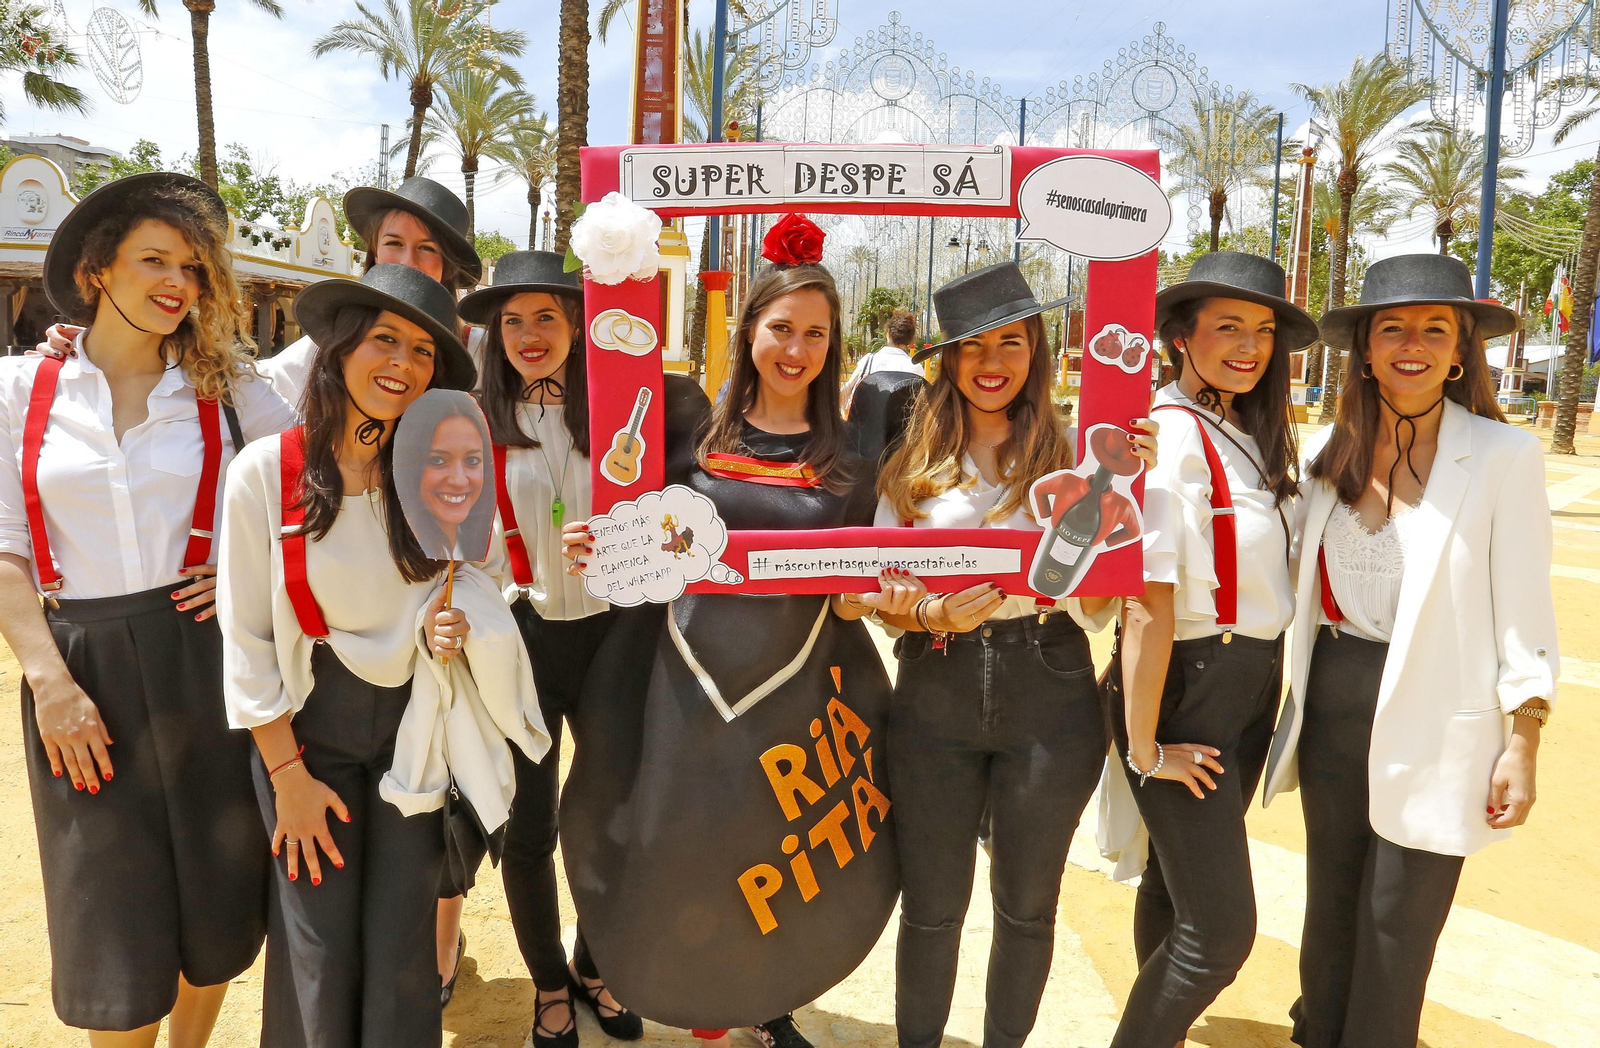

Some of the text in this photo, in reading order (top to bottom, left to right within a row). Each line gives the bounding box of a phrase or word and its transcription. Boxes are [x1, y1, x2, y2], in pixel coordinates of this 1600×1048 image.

[652, 155, 981, 198] SUPER DESPE SÁ
[1045, 188, 1148, 223] #senoscasalaprimera
[588, 514, 651, 538] TENEMOS MÁS
[1059, 524, 1071, 536] TIO
[596, 534, 655, 559] ARTE QUE LA
[601, 555, 650, 576] FLAMENCA
[774, 554, 978, 575] máscontentasqueunascastañuelas
[607, 567, 672, 593] DEL WHATSAPP
